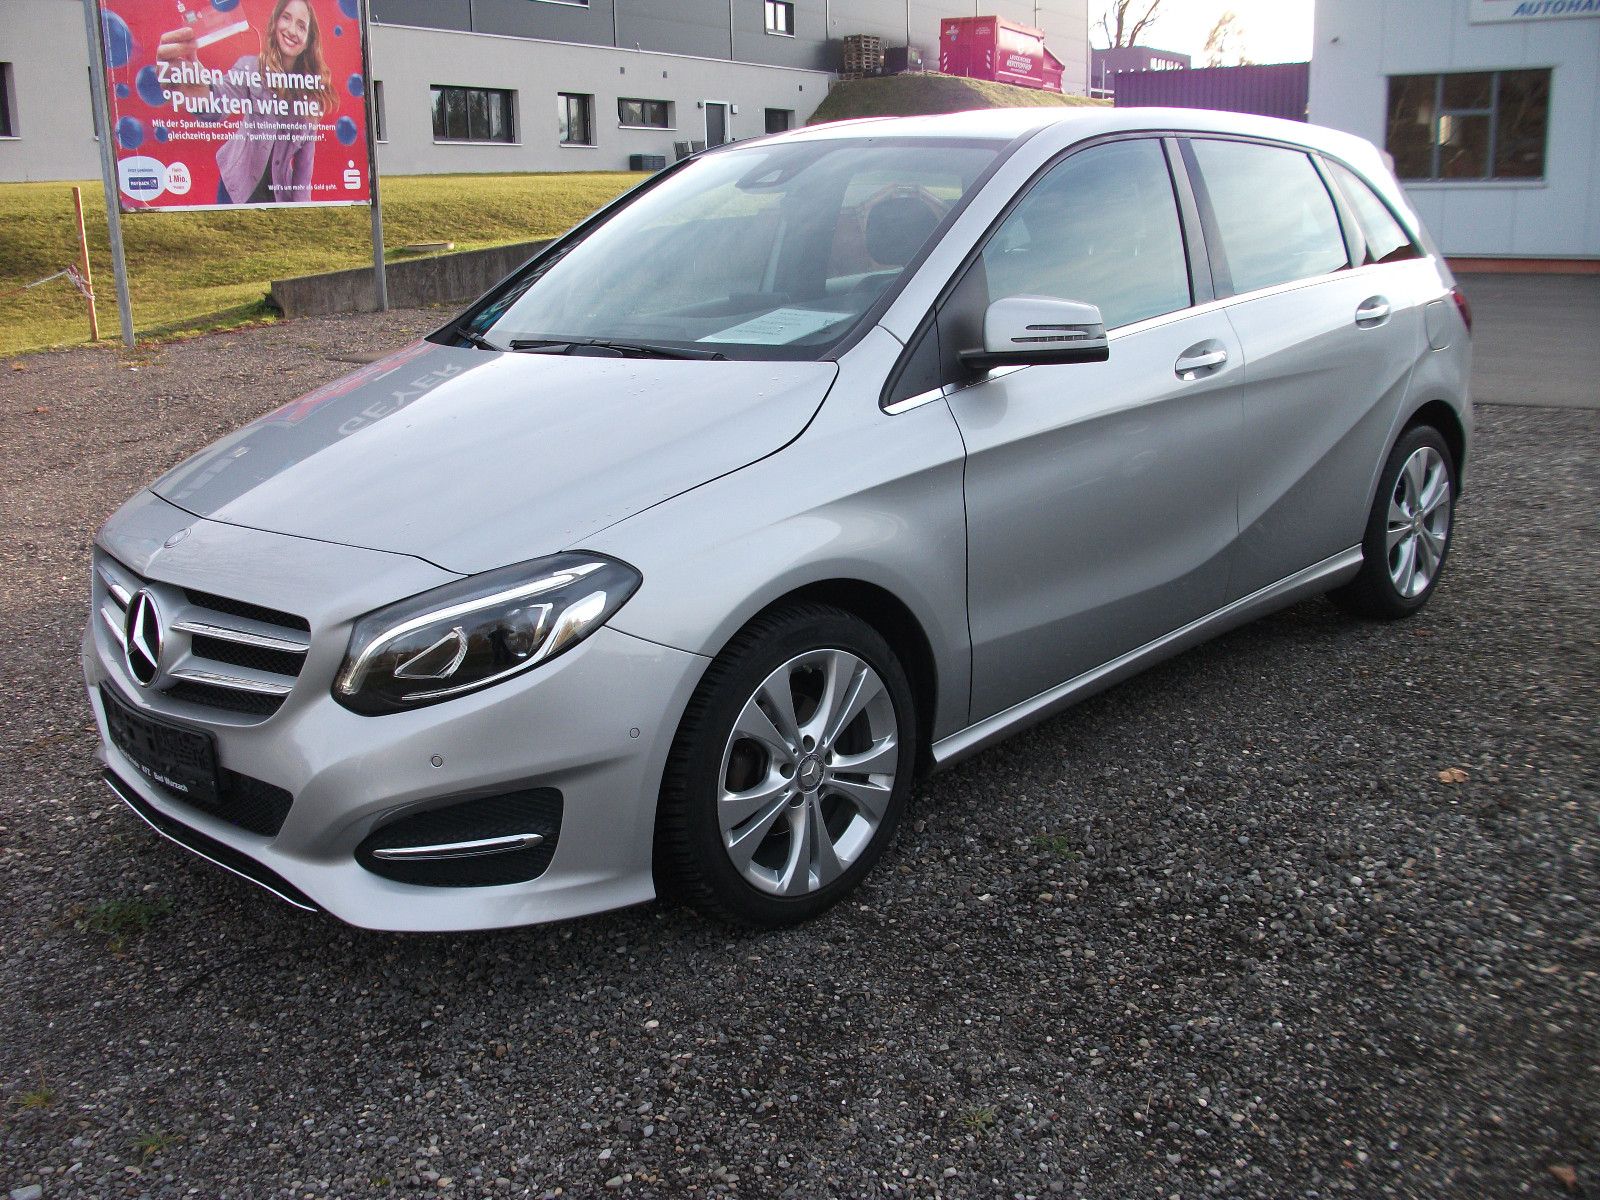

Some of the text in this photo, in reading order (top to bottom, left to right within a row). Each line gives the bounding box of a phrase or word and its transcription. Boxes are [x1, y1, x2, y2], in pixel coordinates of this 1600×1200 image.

[156, 61, 325, 90] Zahlen wie immer.
[257, 94, 289, 116] wie
[293, 95, 324, 116] nie.
[152, 119, 165, 128] Mit
[166, 119, 179, 128] der
[244, 121, 256, 130] bei
[257, 121, 307, 131] teilnehmenden
[308, 123, 336, 131] Partnern
[168, 132, 211, 142] gleichzeitig
[211, 132, 247, 141] bezahlen,
[281, 133, 291, 141] und
[168, 174, 188, 183] 1 Mio.
